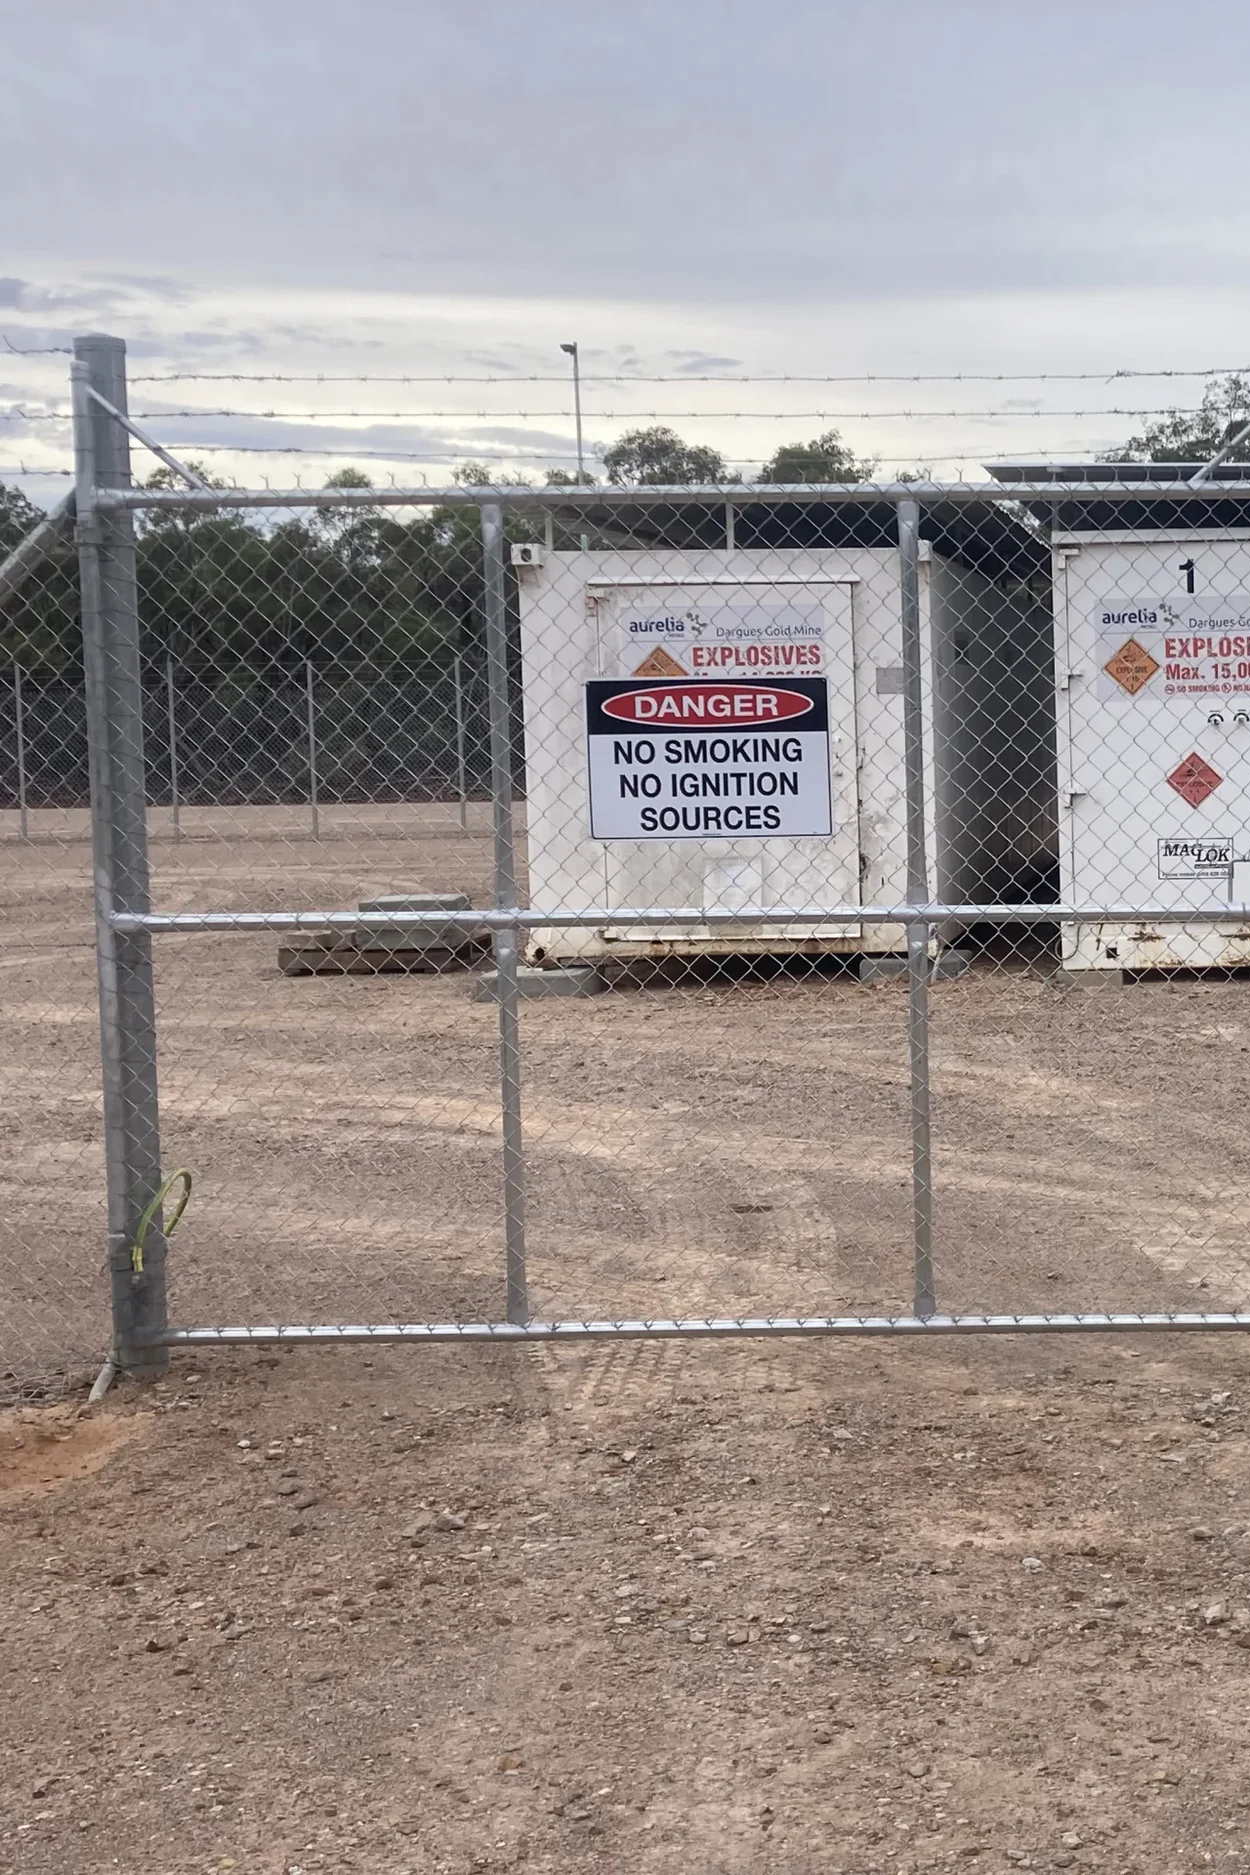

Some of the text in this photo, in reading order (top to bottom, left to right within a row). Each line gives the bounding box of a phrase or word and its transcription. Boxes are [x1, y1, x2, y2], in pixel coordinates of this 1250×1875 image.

[1179, 559, 1194, 593] 1
[629, 616, 685, 632] aurelia
[1102, 608, 1157, 624] aurelia
[1189, 618, 1235, 629] Dargues
[716, 625, 822, 638] Dargues Gold Mine
[692, 645, 821, 667] EXPLOSIVES
[1166, 664, 1205, 680] Max.
[1188, 684, 1220, 693] SMOKING
[634, 694, 778, 718] DANGER
[613, 738, 802, 764] NO SMOKING
[620, 772, 798, 798] NO IGNITION
[640, 805, 781, 831] SOURCES
